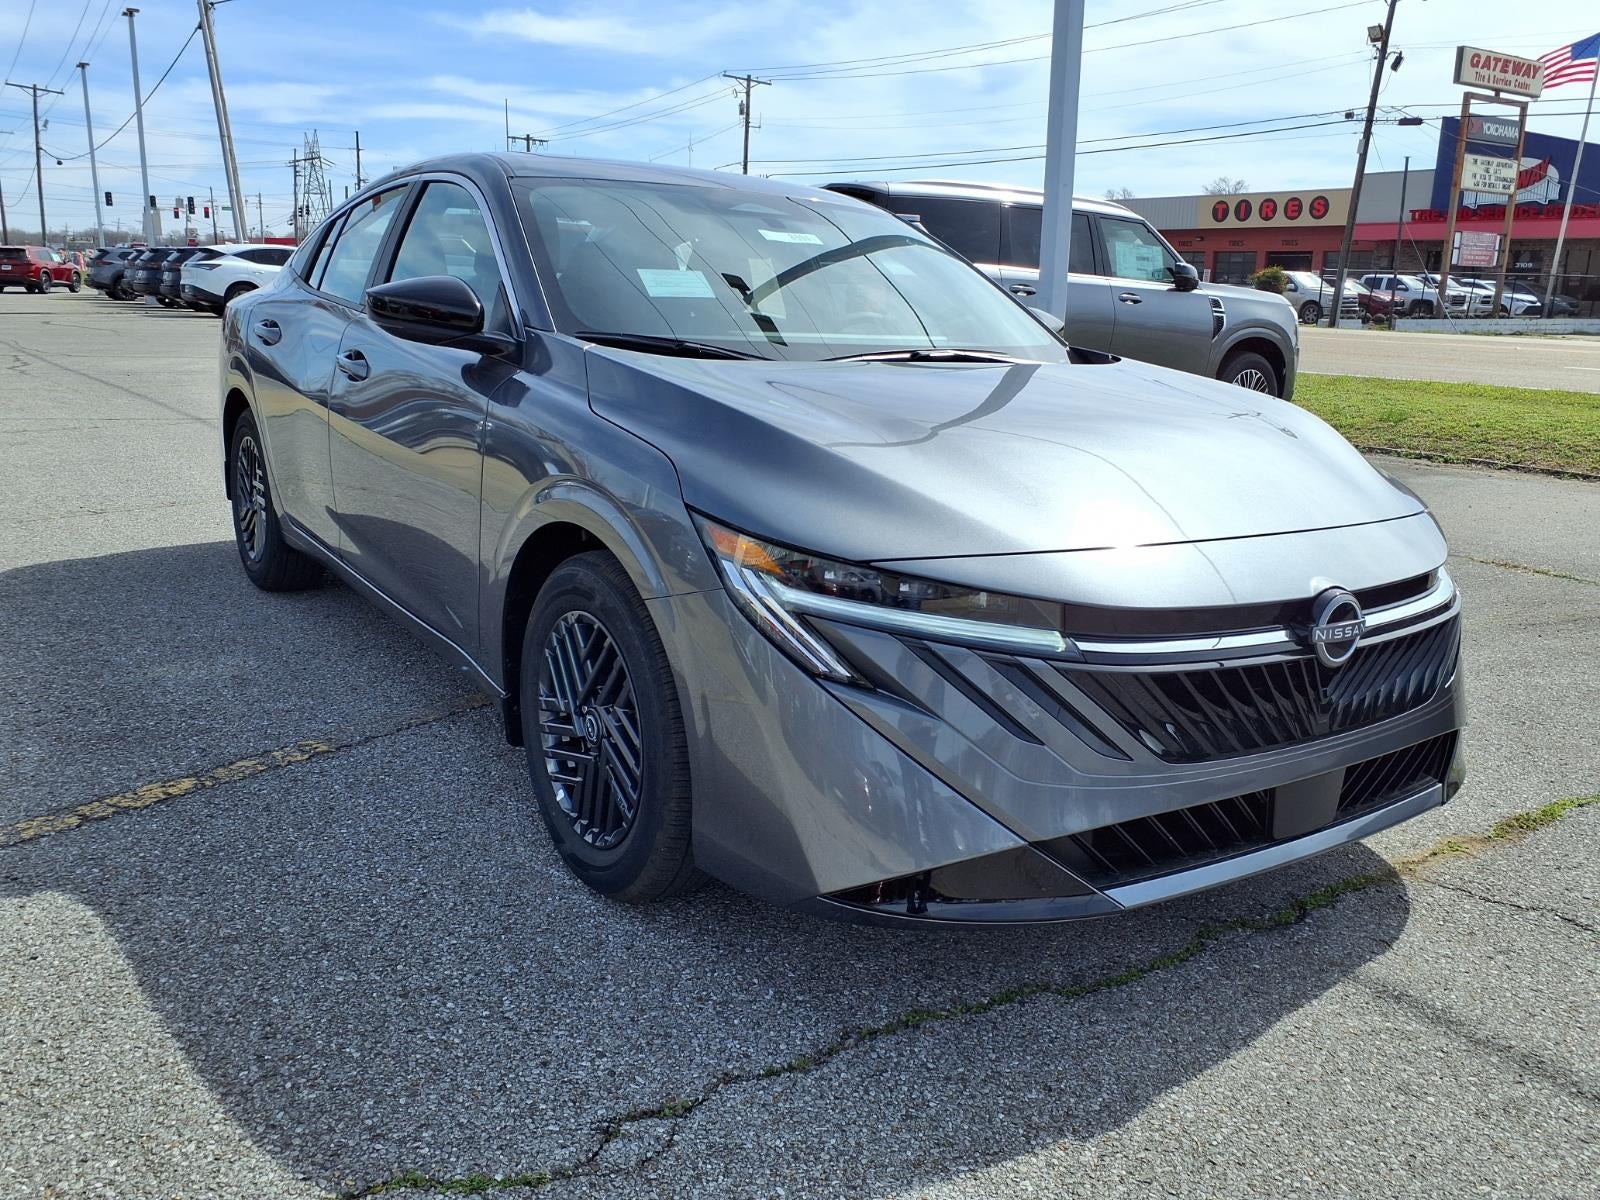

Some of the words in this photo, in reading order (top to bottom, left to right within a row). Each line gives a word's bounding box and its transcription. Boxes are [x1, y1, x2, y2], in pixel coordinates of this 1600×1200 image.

[1470, 53, 1541, 79] GATEWAY
[1475, 72, 1485, 82] Tire
[1493, 74, 1512, 87] Service
[1514, 78, 1531, 91] Center
[1482, 121, 1518, 139] YOKOHAMA
[1215, 198, 1325, 219] TIRES
[1409, 209, 1440, 221] TIRE
[1476, 205, 1538, 220] SERICE
[1315, 623, 1365, 640] NISSAN
